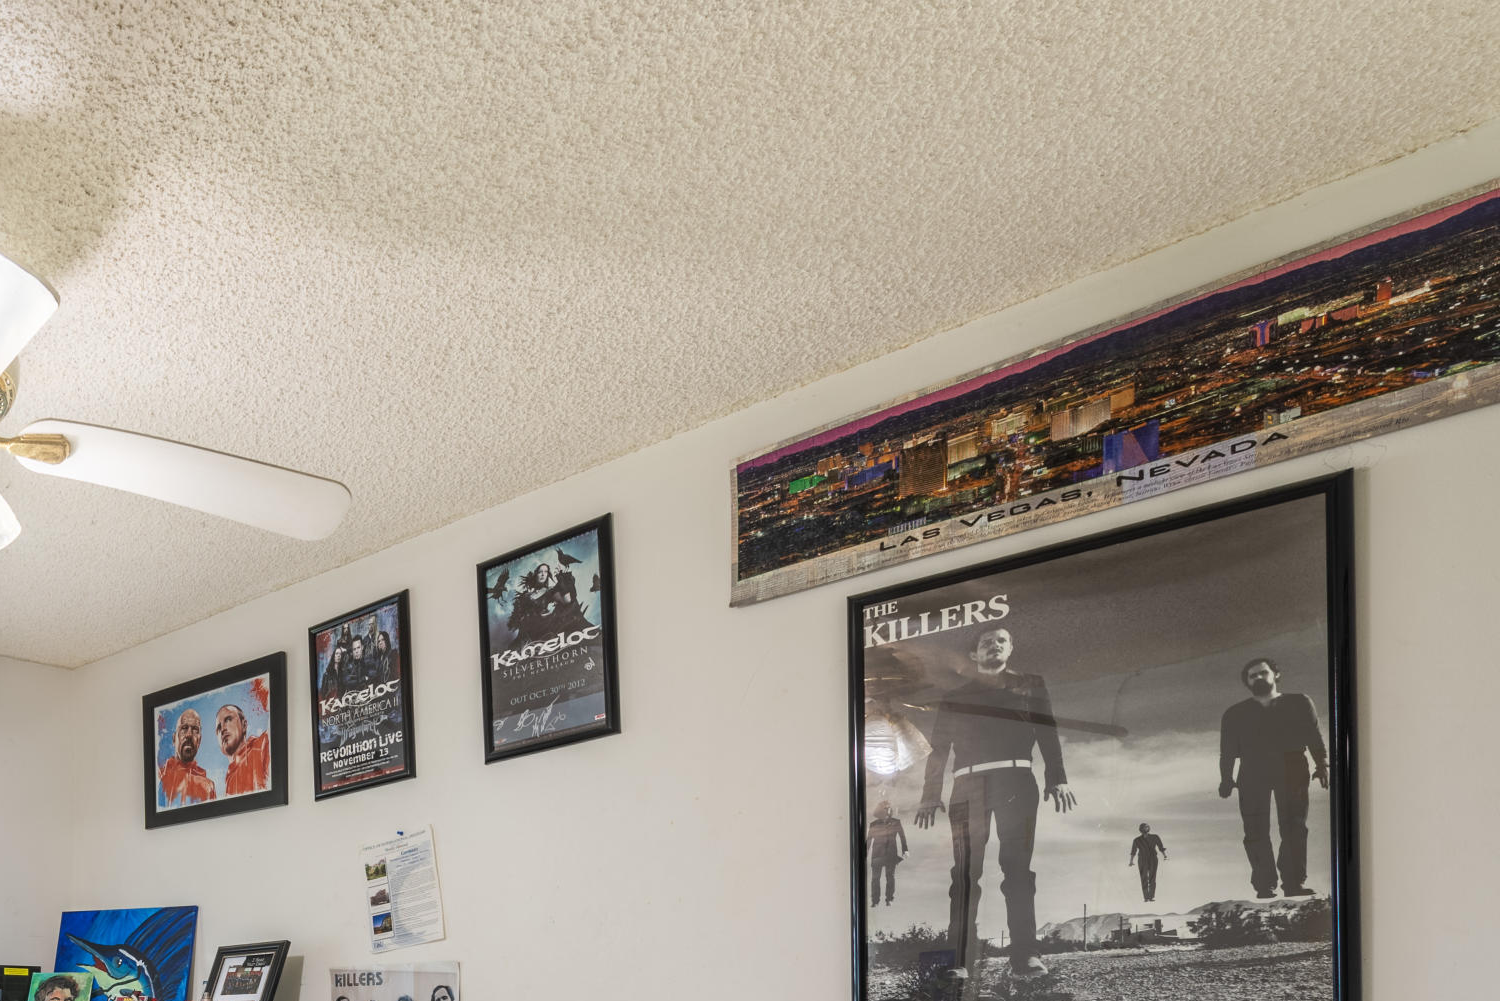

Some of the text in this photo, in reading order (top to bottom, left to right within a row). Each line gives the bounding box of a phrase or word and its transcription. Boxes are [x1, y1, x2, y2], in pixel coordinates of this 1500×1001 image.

[879, 527, 941, 552] LAS
[959, 489, 1093, 528] VEGAS,
[1116, 431, 1289, 487] NEVADA
[863, 601, 899, 620] THE
[864, 594, 1010, 649] KILLERS
[503, 646, 588, 679] SILVERTHORN
[510, 694, 528, 706] OUT
[567, 679, 586, 690] 2012
[322, 709, 351, 728] NORTH
[353, 698, 392, 719] AMERICA
[379, 747, 389, 757] 13
[334, 971, 383, 987] KILLERS
